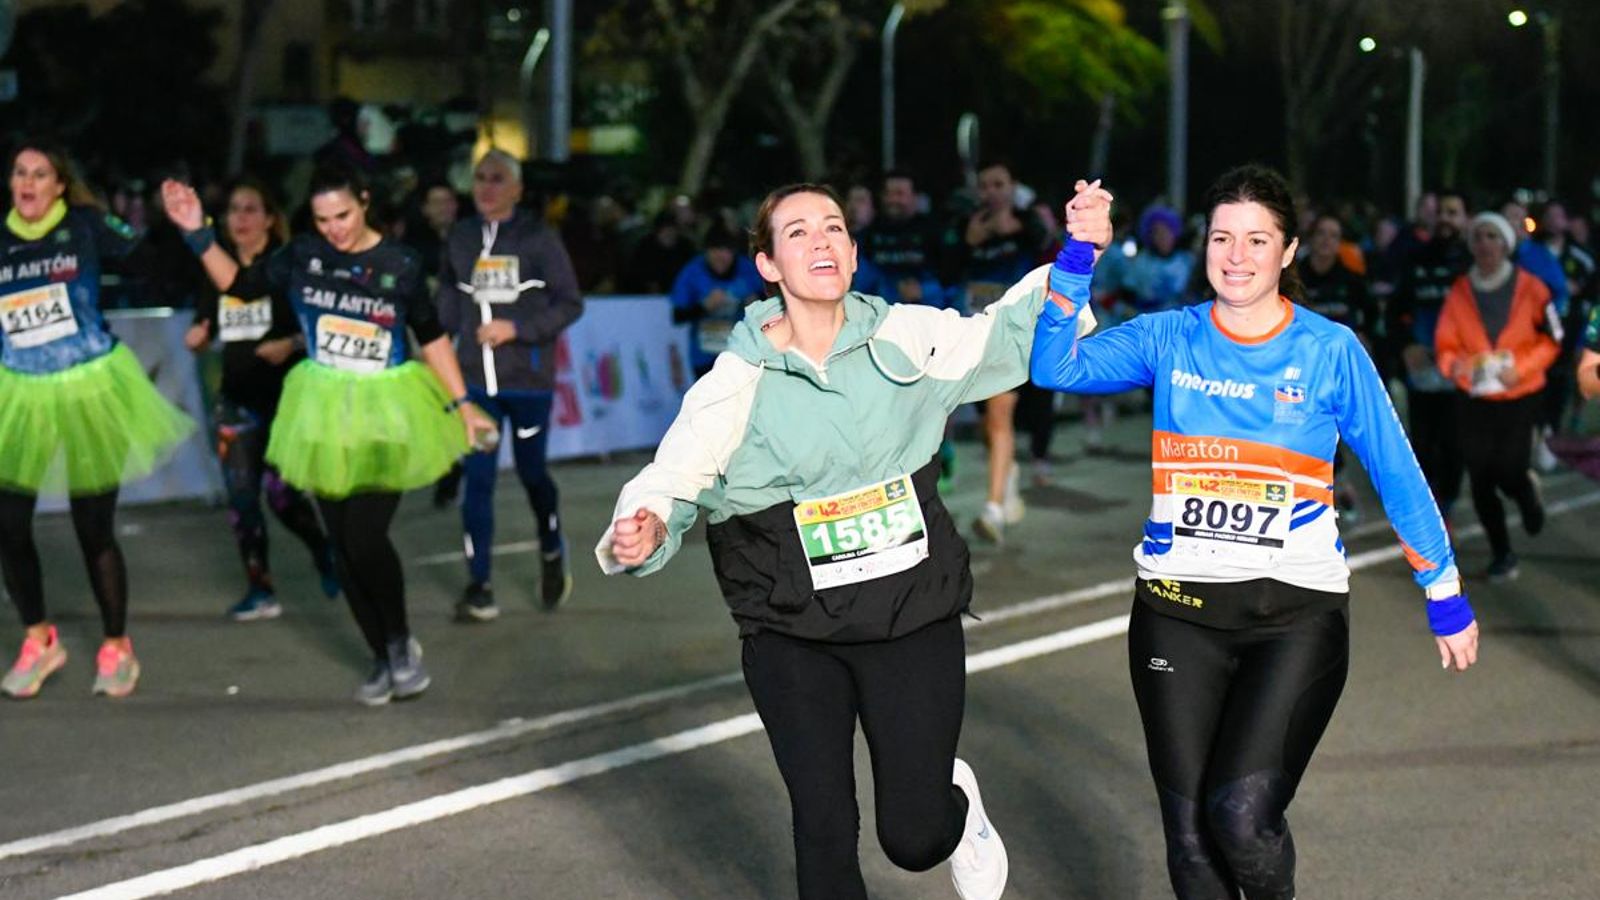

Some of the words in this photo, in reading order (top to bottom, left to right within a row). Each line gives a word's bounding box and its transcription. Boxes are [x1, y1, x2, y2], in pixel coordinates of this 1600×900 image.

[303, 286, 336, 310] SAN
[1171, 369, 1256, 399] enerplus
[1160, 437, 1239, 461] Maratón
[811, 501, 911, 555] 1585
[1181, 497, 1280, 535] 8097
